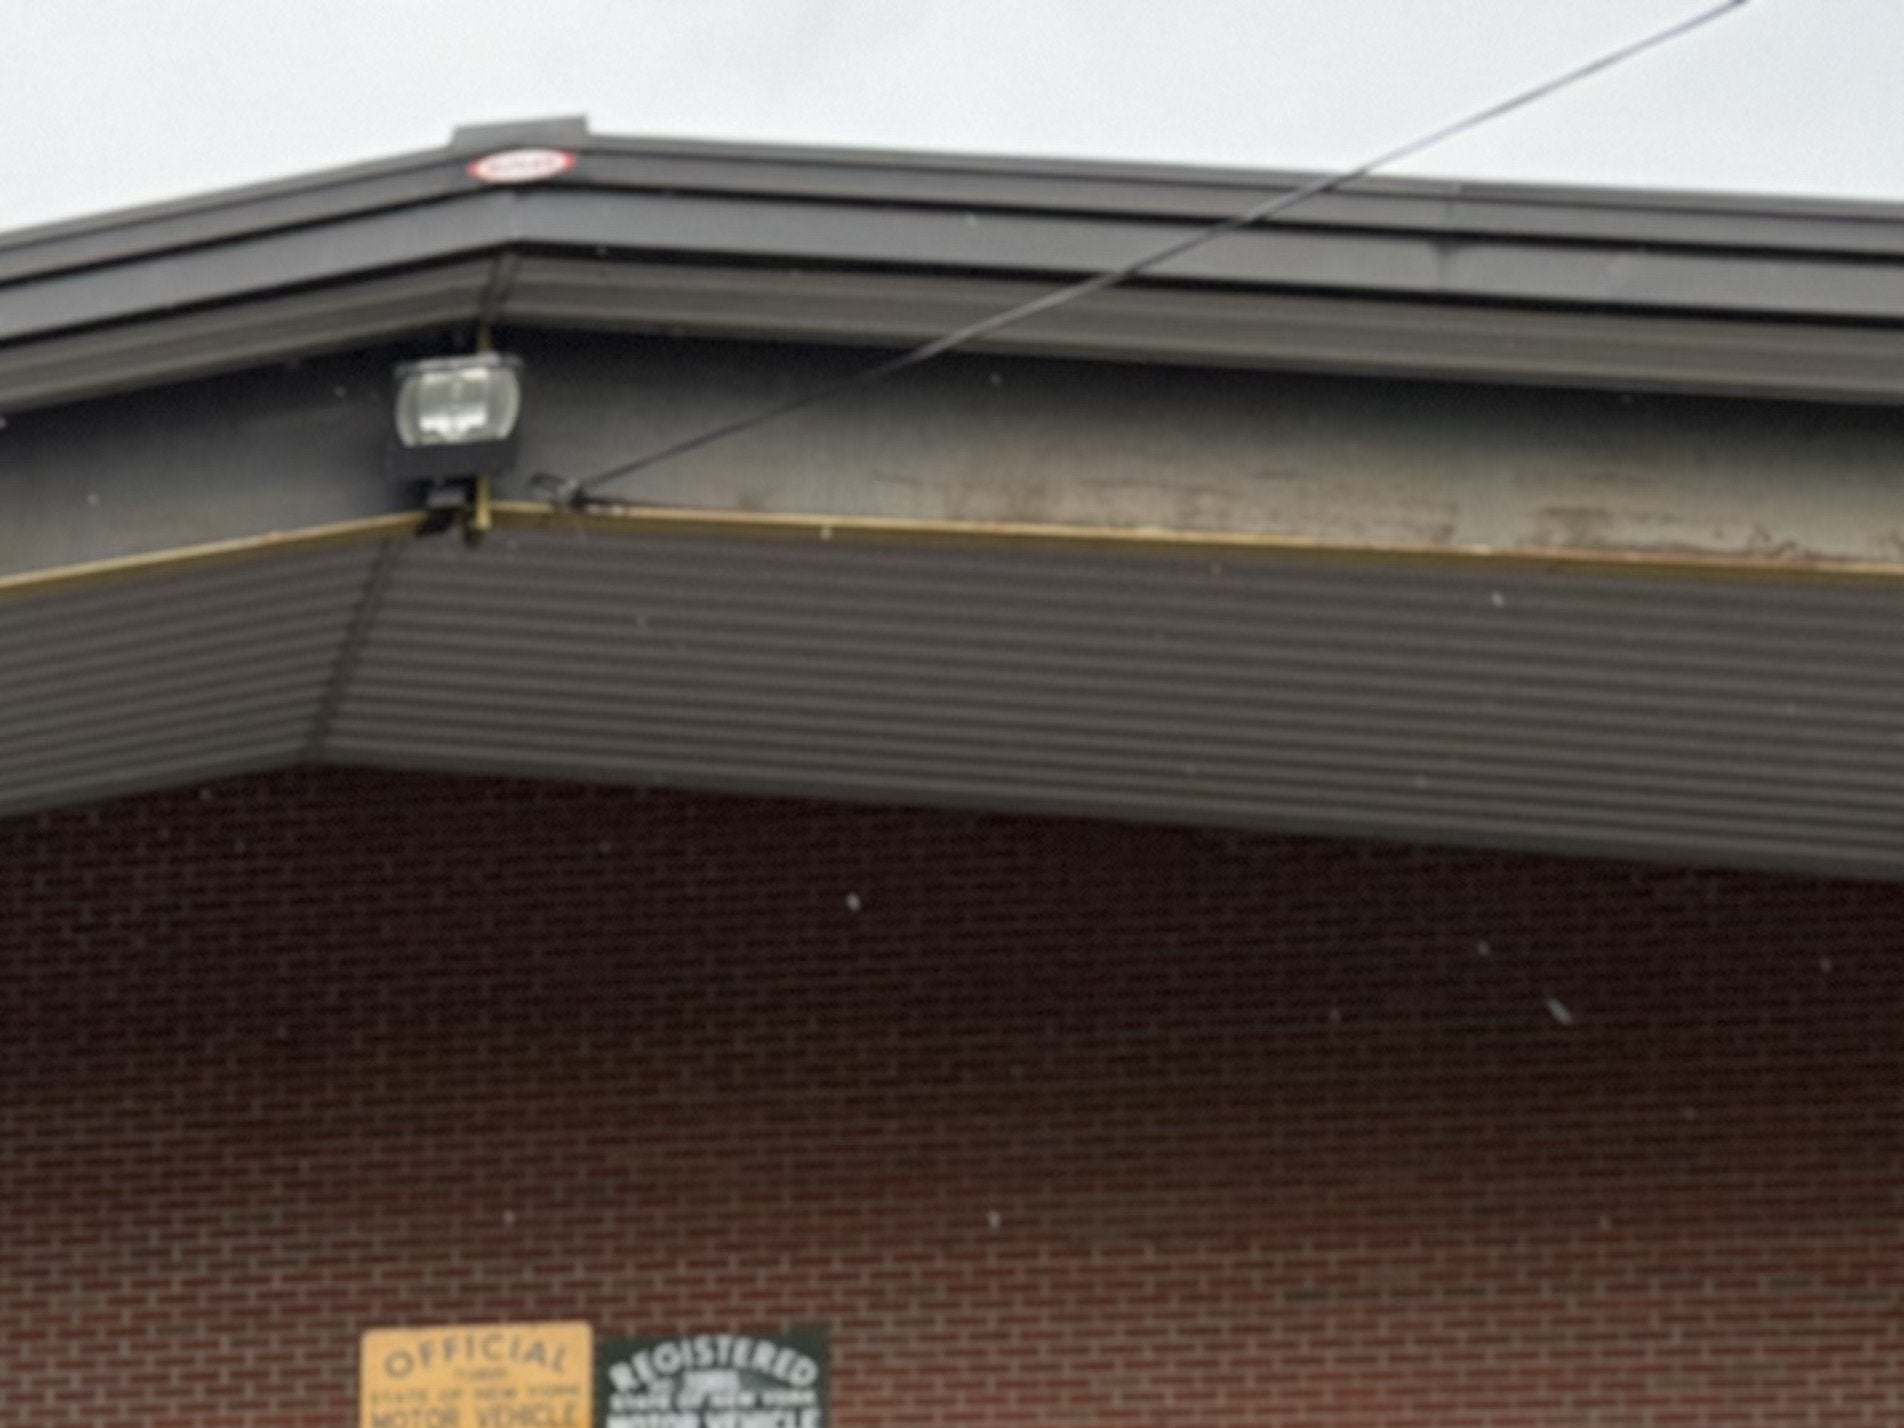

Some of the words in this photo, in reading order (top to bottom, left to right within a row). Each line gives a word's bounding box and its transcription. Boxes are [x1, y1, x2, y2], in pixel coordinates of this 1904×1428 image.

[384, 1333, 567, 1379] OFFICIAL
[608, 1333, 819, 1393] REGISTERED
[476, 1402, 578, 1428] VEHICLE
